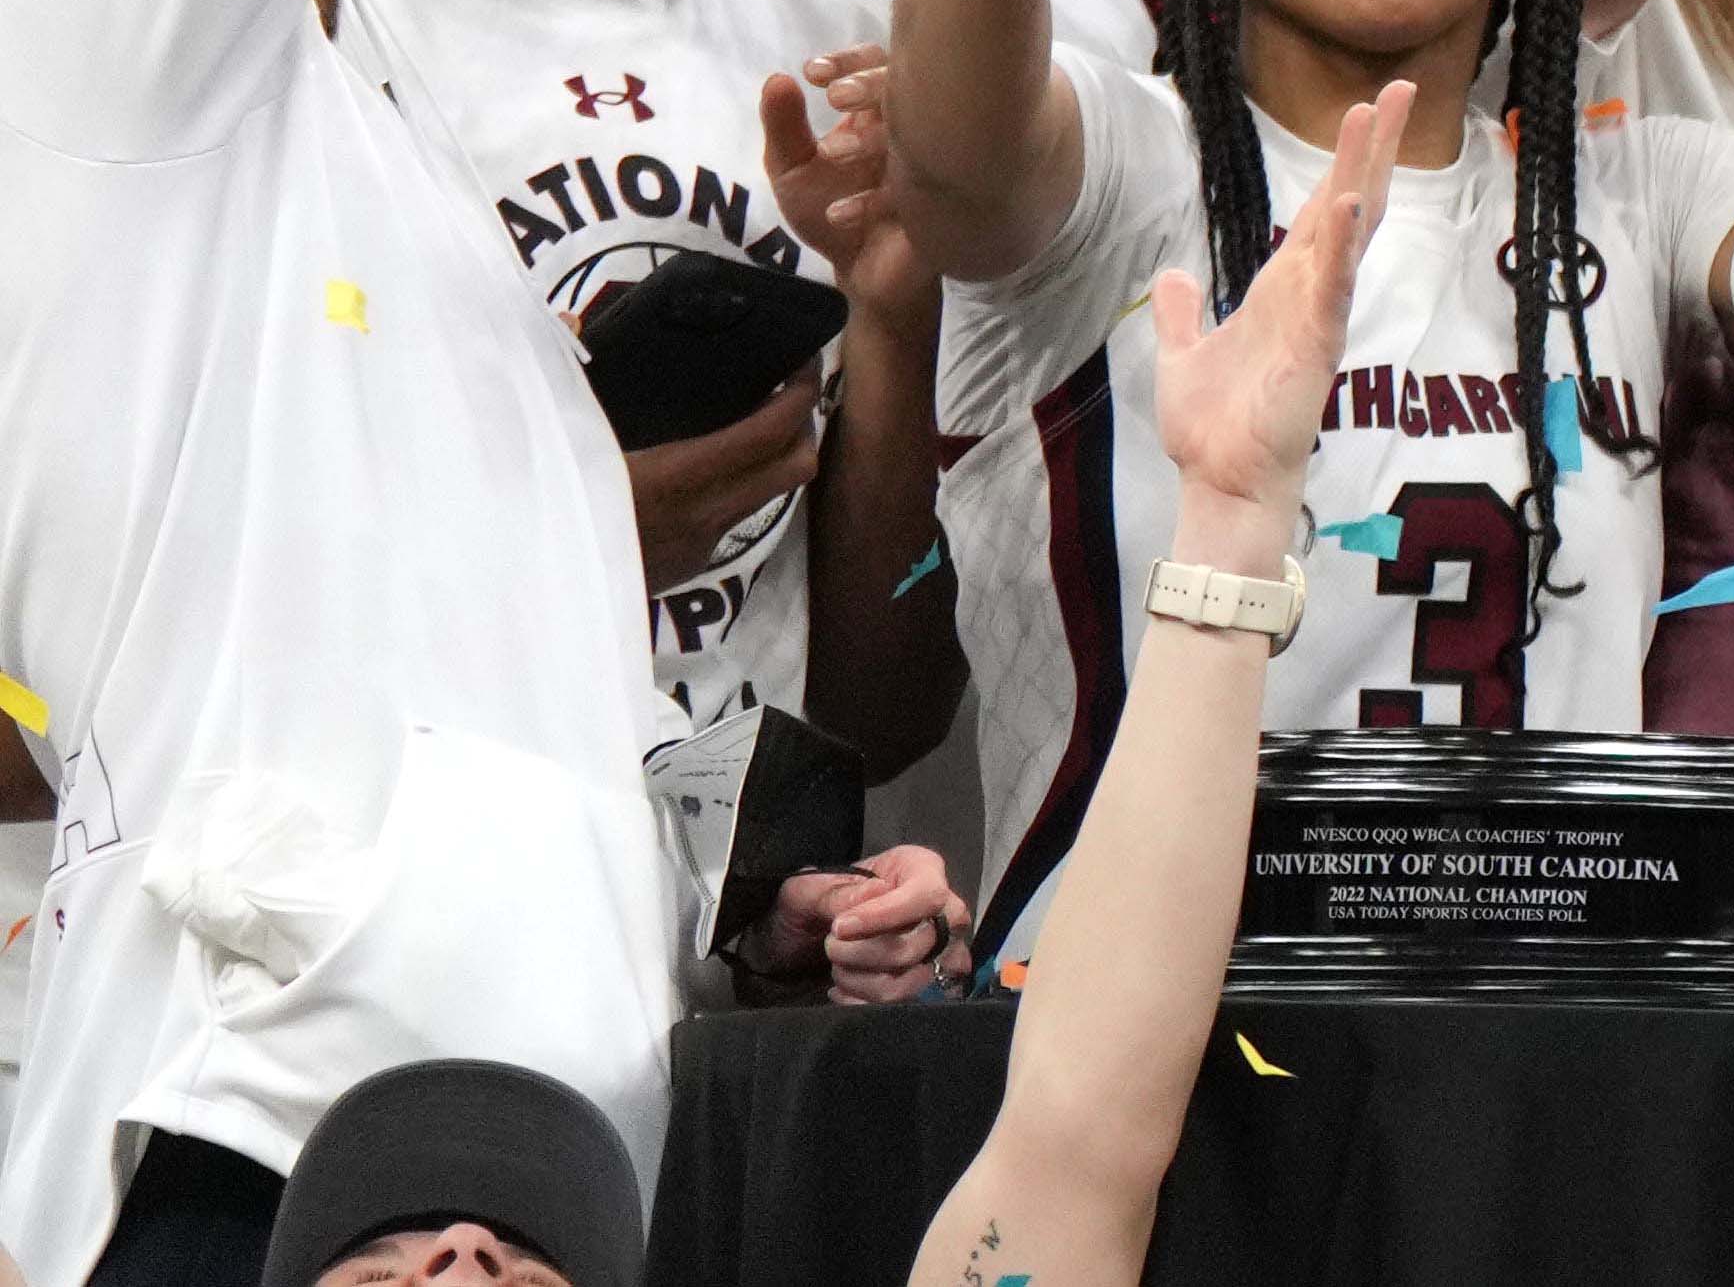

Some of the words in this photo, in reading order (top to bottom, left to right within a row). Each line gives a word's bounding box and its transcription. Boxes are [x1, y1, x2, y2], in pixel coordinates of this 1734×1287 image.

[1359, 482, 1530, 729] 3
[1303, 827, 1369, 842] INVESCO
[1372, 828, 1408, 845] QQQ
[1412, 828, 1461, 843] WBCA
[1555, 830, 1624, 846] TROPHY
[1255, 853, 1396, 875] UNIVERSITY
[1401, 853, 1437, 875] OF
[1442, 854, 1533, 877] SOUTH
[1540, 855, 1680, 882] CAROLINA
[1328, 886, 1365, 902] 2022
[1369, 886, 1471, 903] NATIONAL
[1475, 887, 1588, 905] CHAMPION
[1328, 906, 1356, 919] USA
[1359, 906, 1410, 920] TODAY
[1412, 906, 1469, 920] SPORTS
[1471, 907, 1544, 922] COACHES
[1548, 908, 1587, 923] POLL
